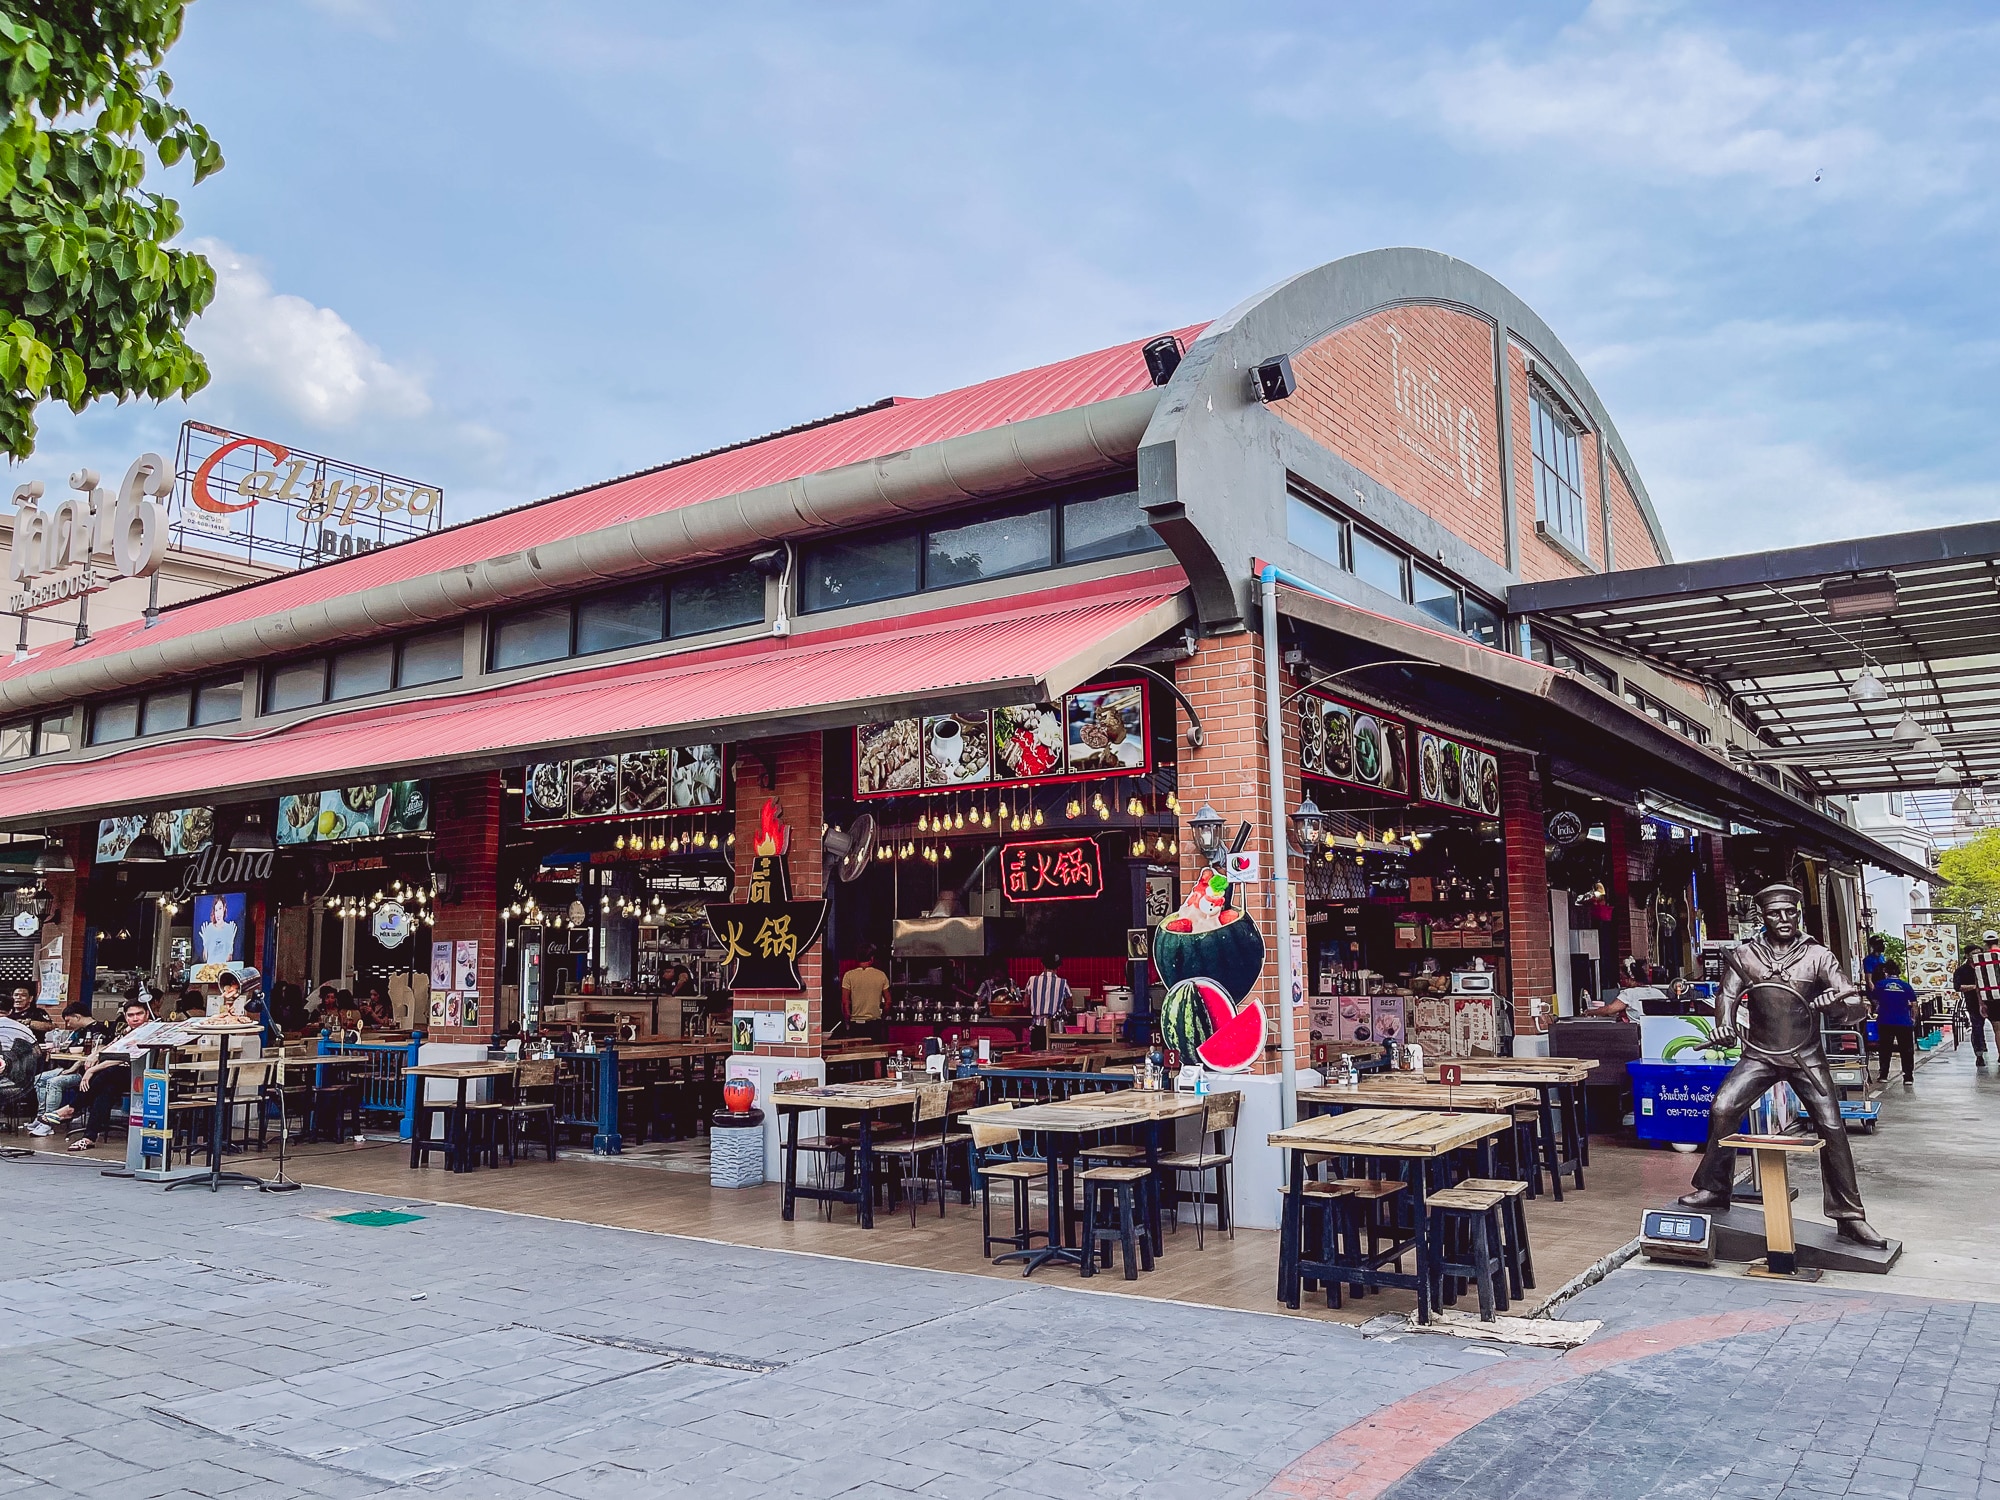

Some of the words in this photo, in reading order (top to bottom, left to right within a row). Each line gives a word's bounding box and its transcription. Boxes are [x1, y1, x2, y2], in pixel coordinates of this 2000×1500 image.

[1397, 426, 1456, 480] WAREHOUSE
[1458, 405, 1482, 499] 6
[191, 437, 439, 526] Calypso
[113, 452, 175, 577] 6
[8, 570, 98, 612] WAREHOUSE
[172, 844, 274, 900] Aloha
[1031, 847, 1093, 891] 火锅
[720, 914, 798, 966] 火锅
[1316, 998, 1332, 1006] BEST
[918, 1044, 923, 1056] 2
[962, 1029, 970, 1039] 16
[1150, 1032, 1161, 1044] 15
[1319, 1047, 1324, 1060] 6
[1169, 1052, 1175, 1065] 3
[1446, 1068, 1455, 1083] 4
